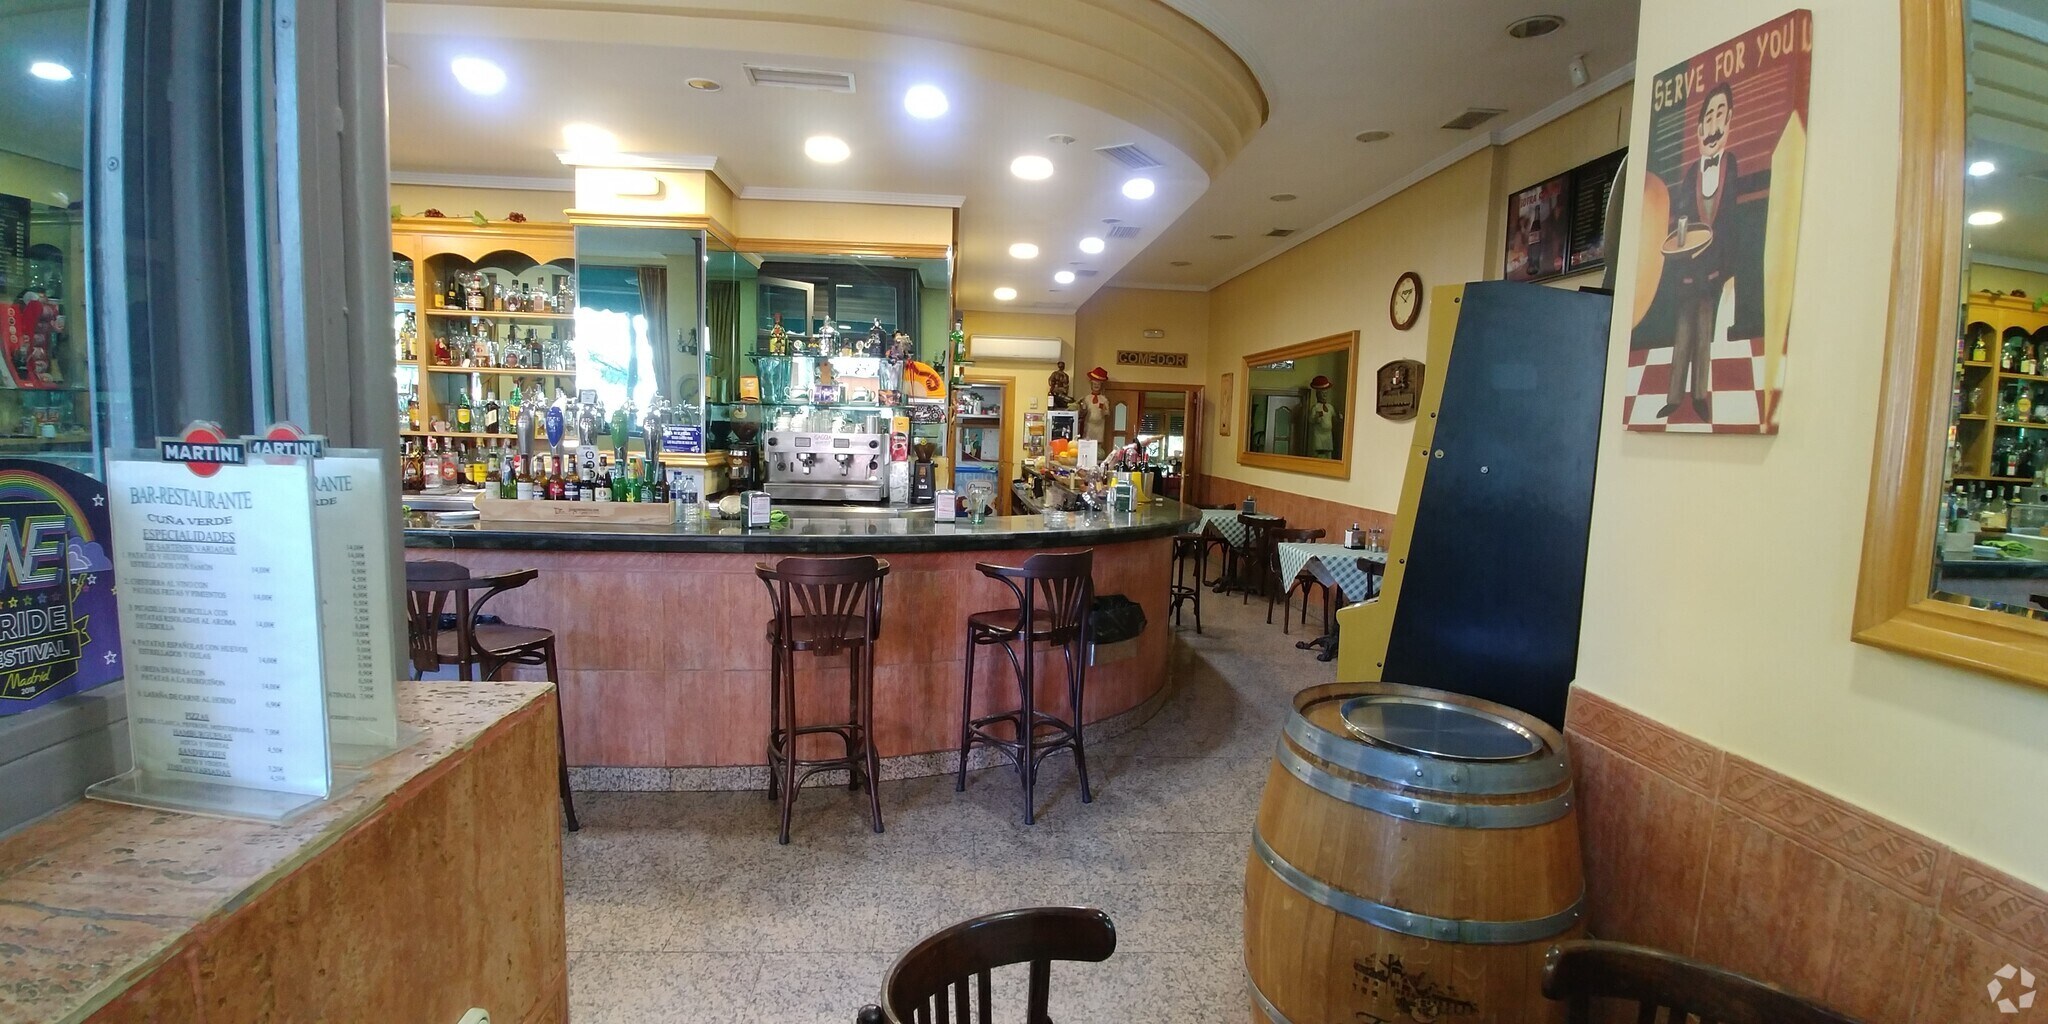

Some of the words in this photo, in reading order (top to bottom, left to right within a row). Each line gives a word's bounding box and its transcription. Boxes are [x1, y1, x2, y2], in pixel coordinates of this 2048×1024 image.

[1654, 64, 1704, 111] SERVE
[1715, 41, 1745, 82] FOR
[1757, 18, 1794, 67] YOU
[1119, 352, 1185, 366] COMEDOR
[165, 444, 239, 462] MARTINI
[130, 486, 253, 510] BAR-RESTAURANTE
[147, 513, 184, 526] CUÑA
[187, 516, 232, 526] VERDE
[143, 528, 236, 543] ESPECIALIDADES
[195, 544, 234, 554] VARIADAS
[0, 605, 68, 641] RIDE
[2, 666, 51, 696] Madrid
[185, 712, 209, 721] PIZZAS
[178, 748, 226, 759] SANDWICHES
